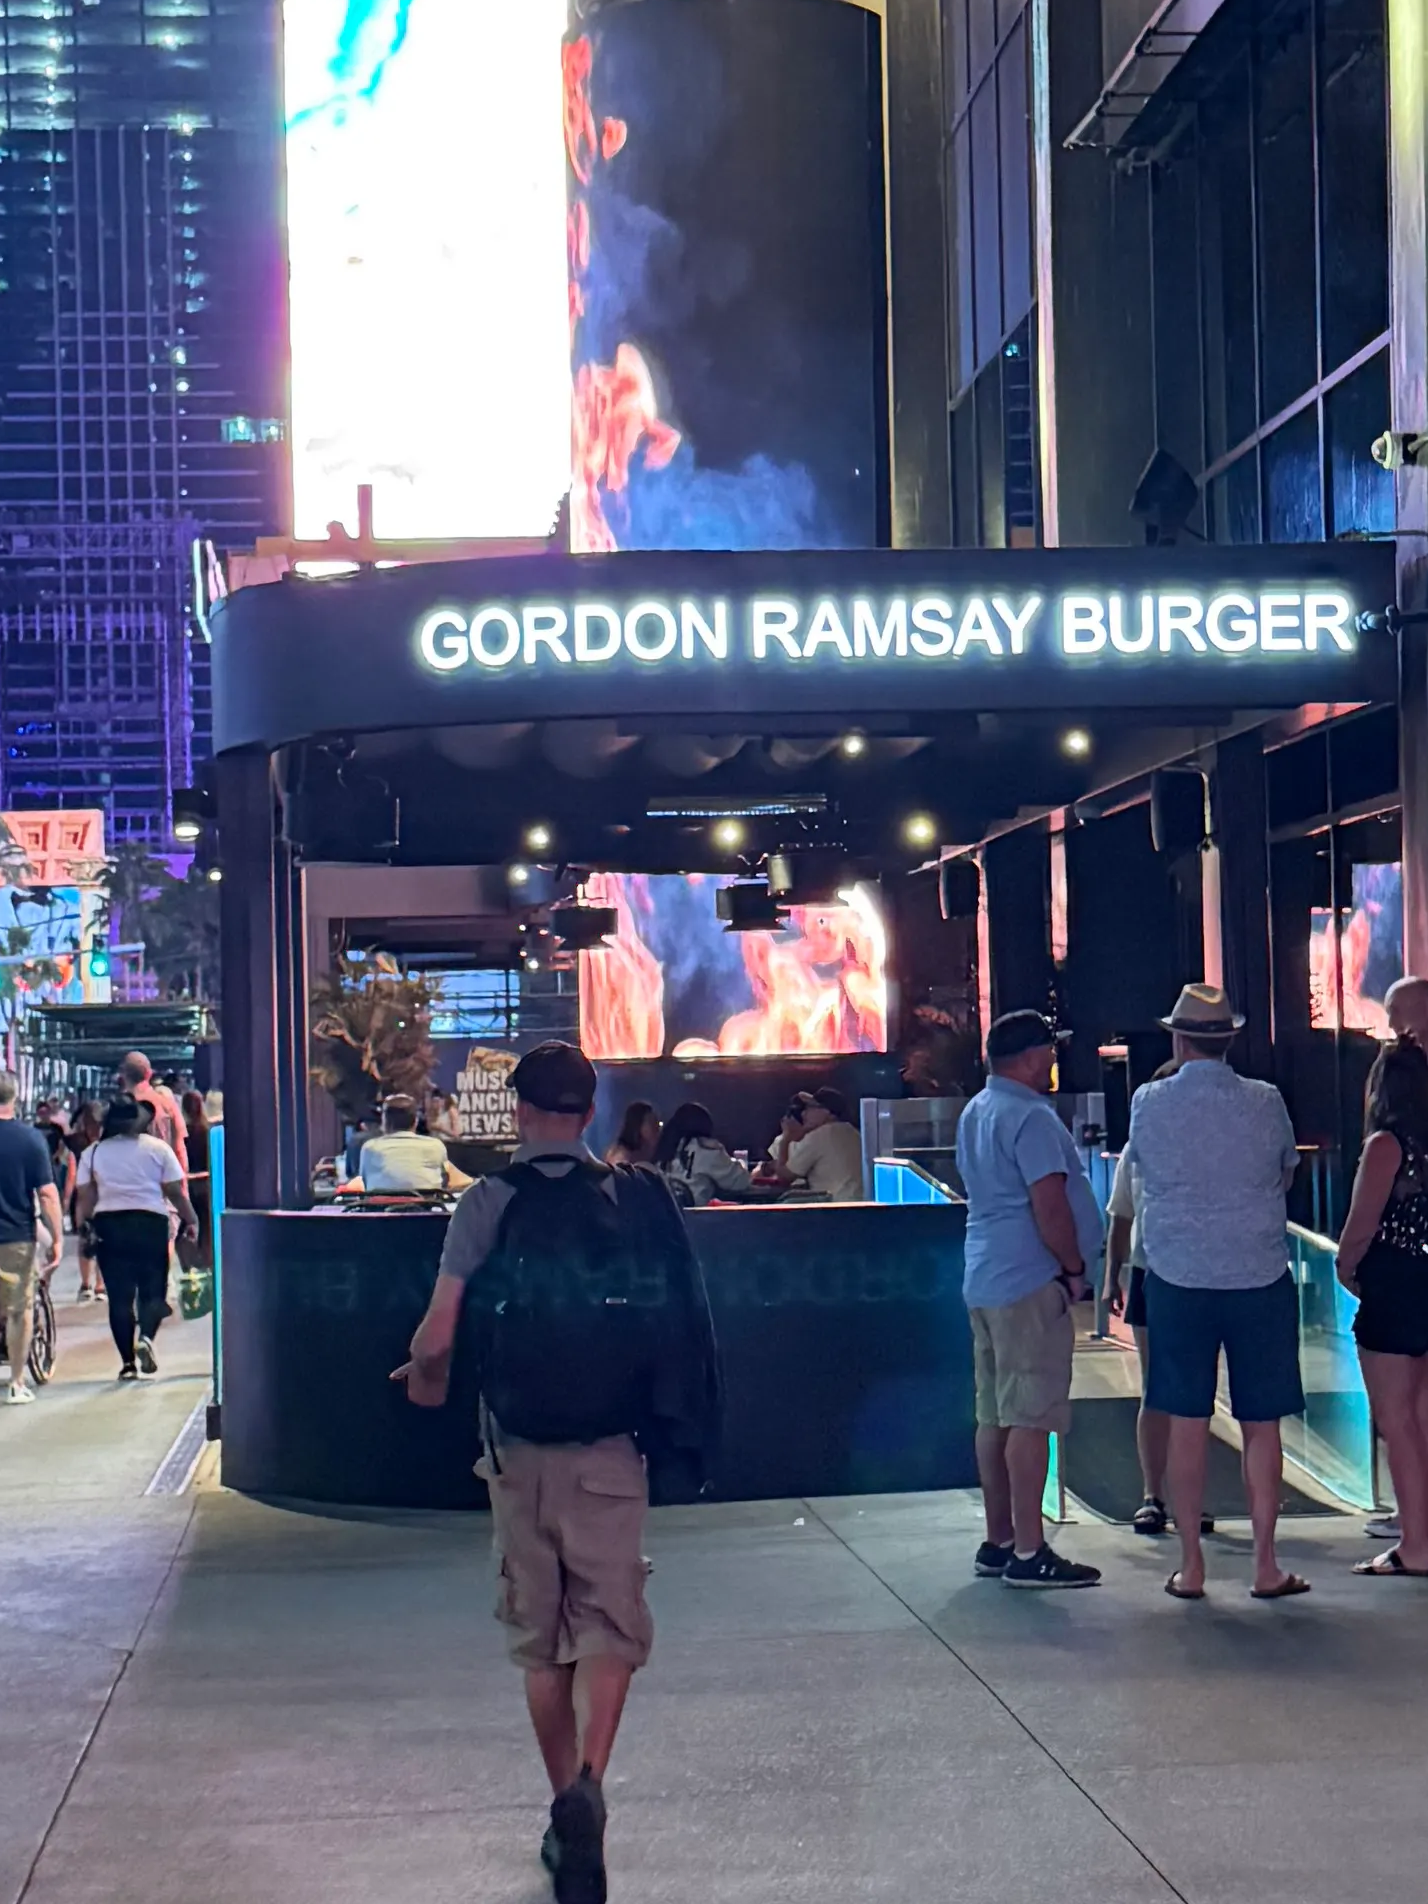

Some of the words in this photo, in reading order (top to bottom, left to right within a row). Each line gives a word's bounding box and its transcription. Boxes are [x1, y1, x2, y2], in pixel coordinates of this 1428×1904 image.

[421, 600, 728, 670] GORDON
[753, 595, 1041, 659] RAMSAY
[1062, 594, 1353, 654] BURGER
